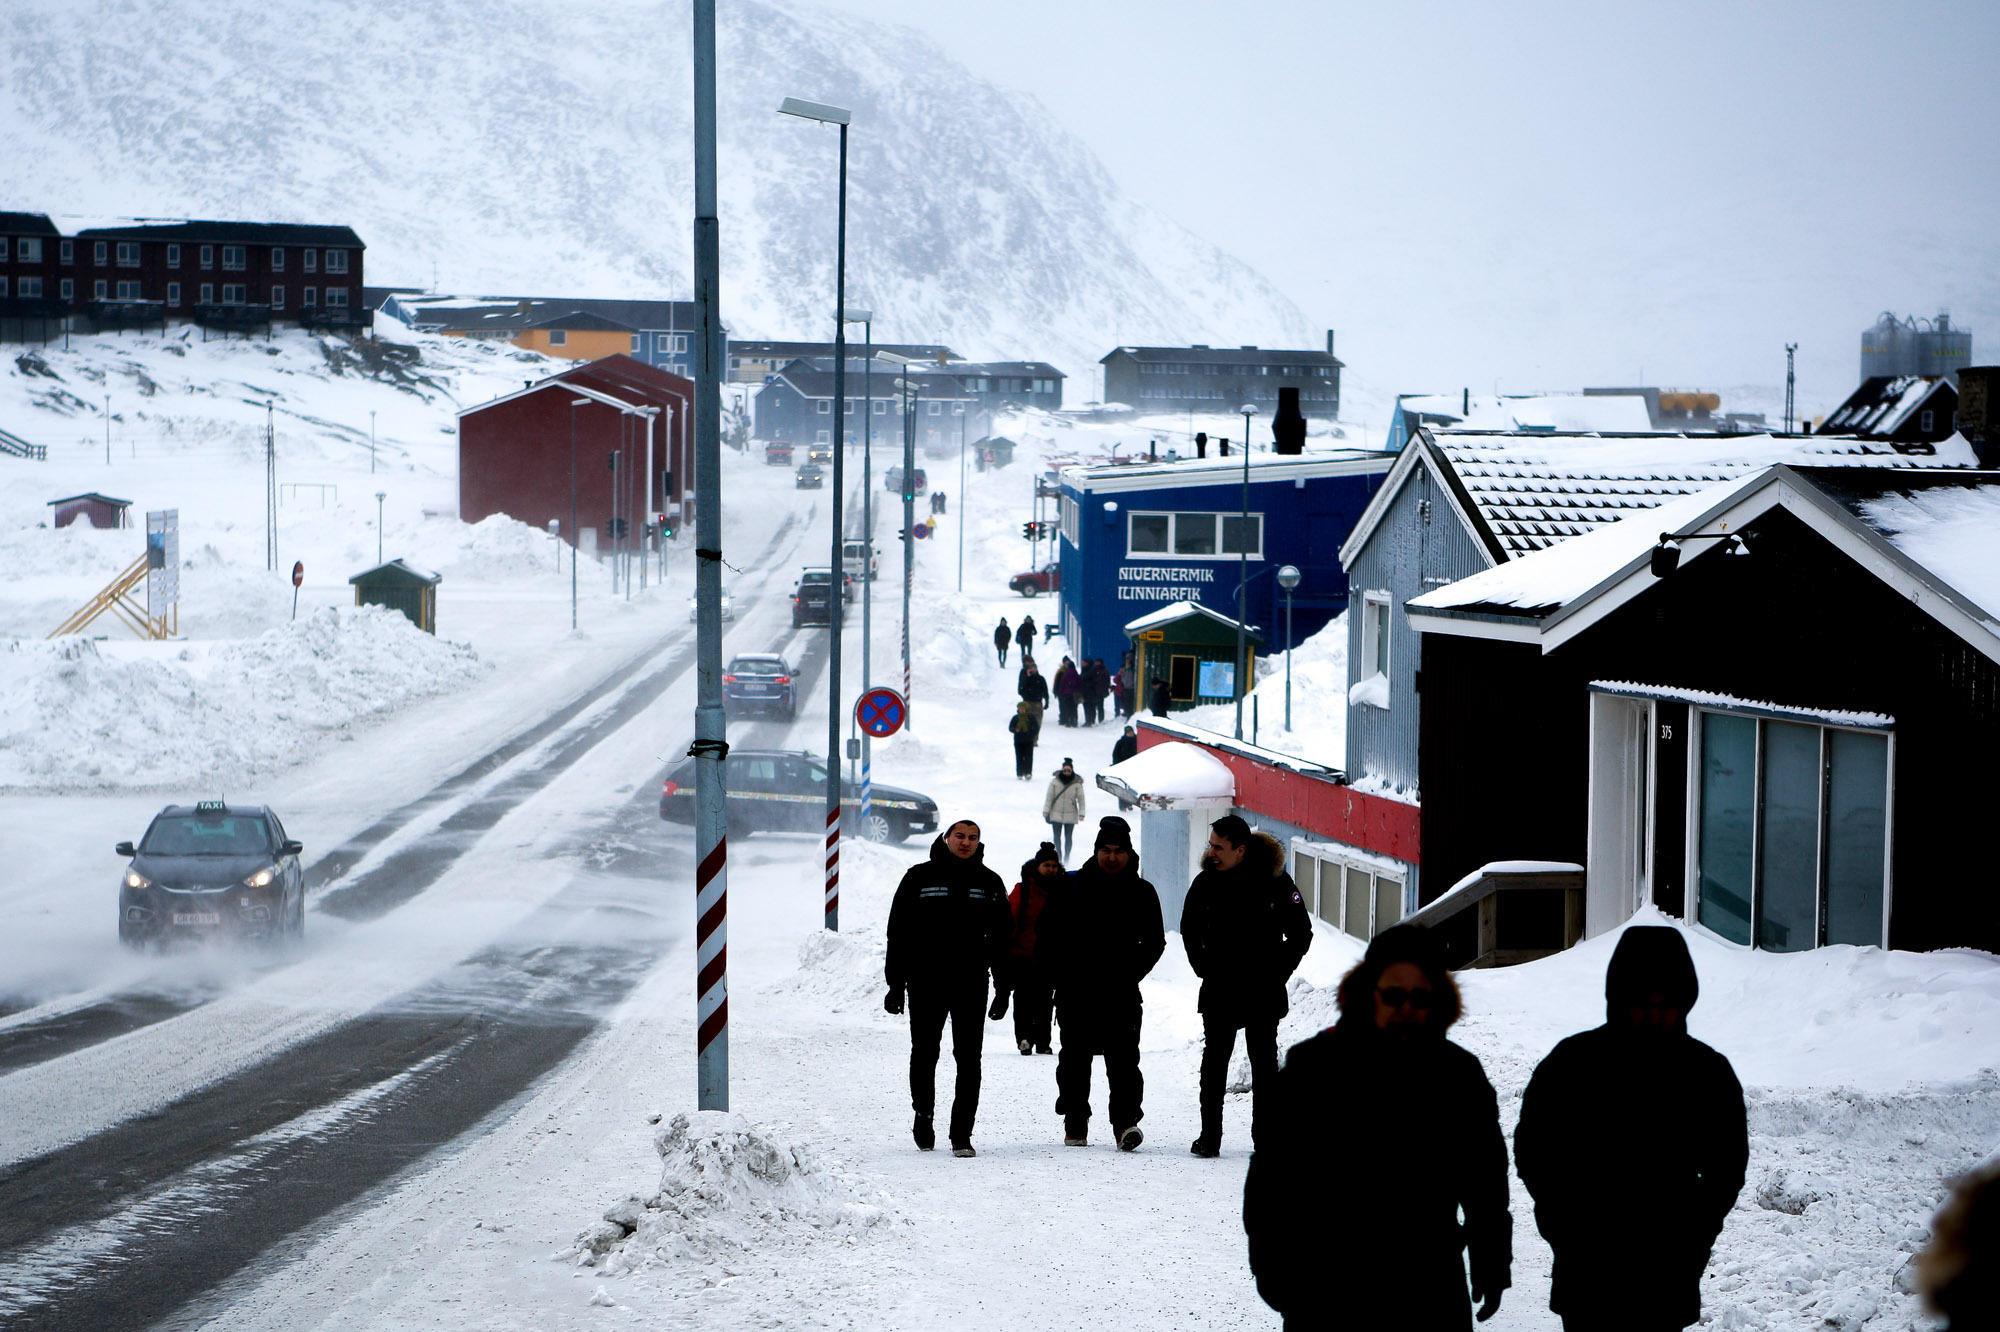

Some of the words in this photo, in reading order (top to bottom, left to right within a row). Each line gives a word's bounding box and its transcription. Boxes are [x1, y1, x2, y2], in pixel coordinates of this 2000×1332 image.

[1118, 586, 1201, 601] ILINNIARFIK
[1661, 725, 1672, 740] 375
[200, 801, 224, 810] TAXI
